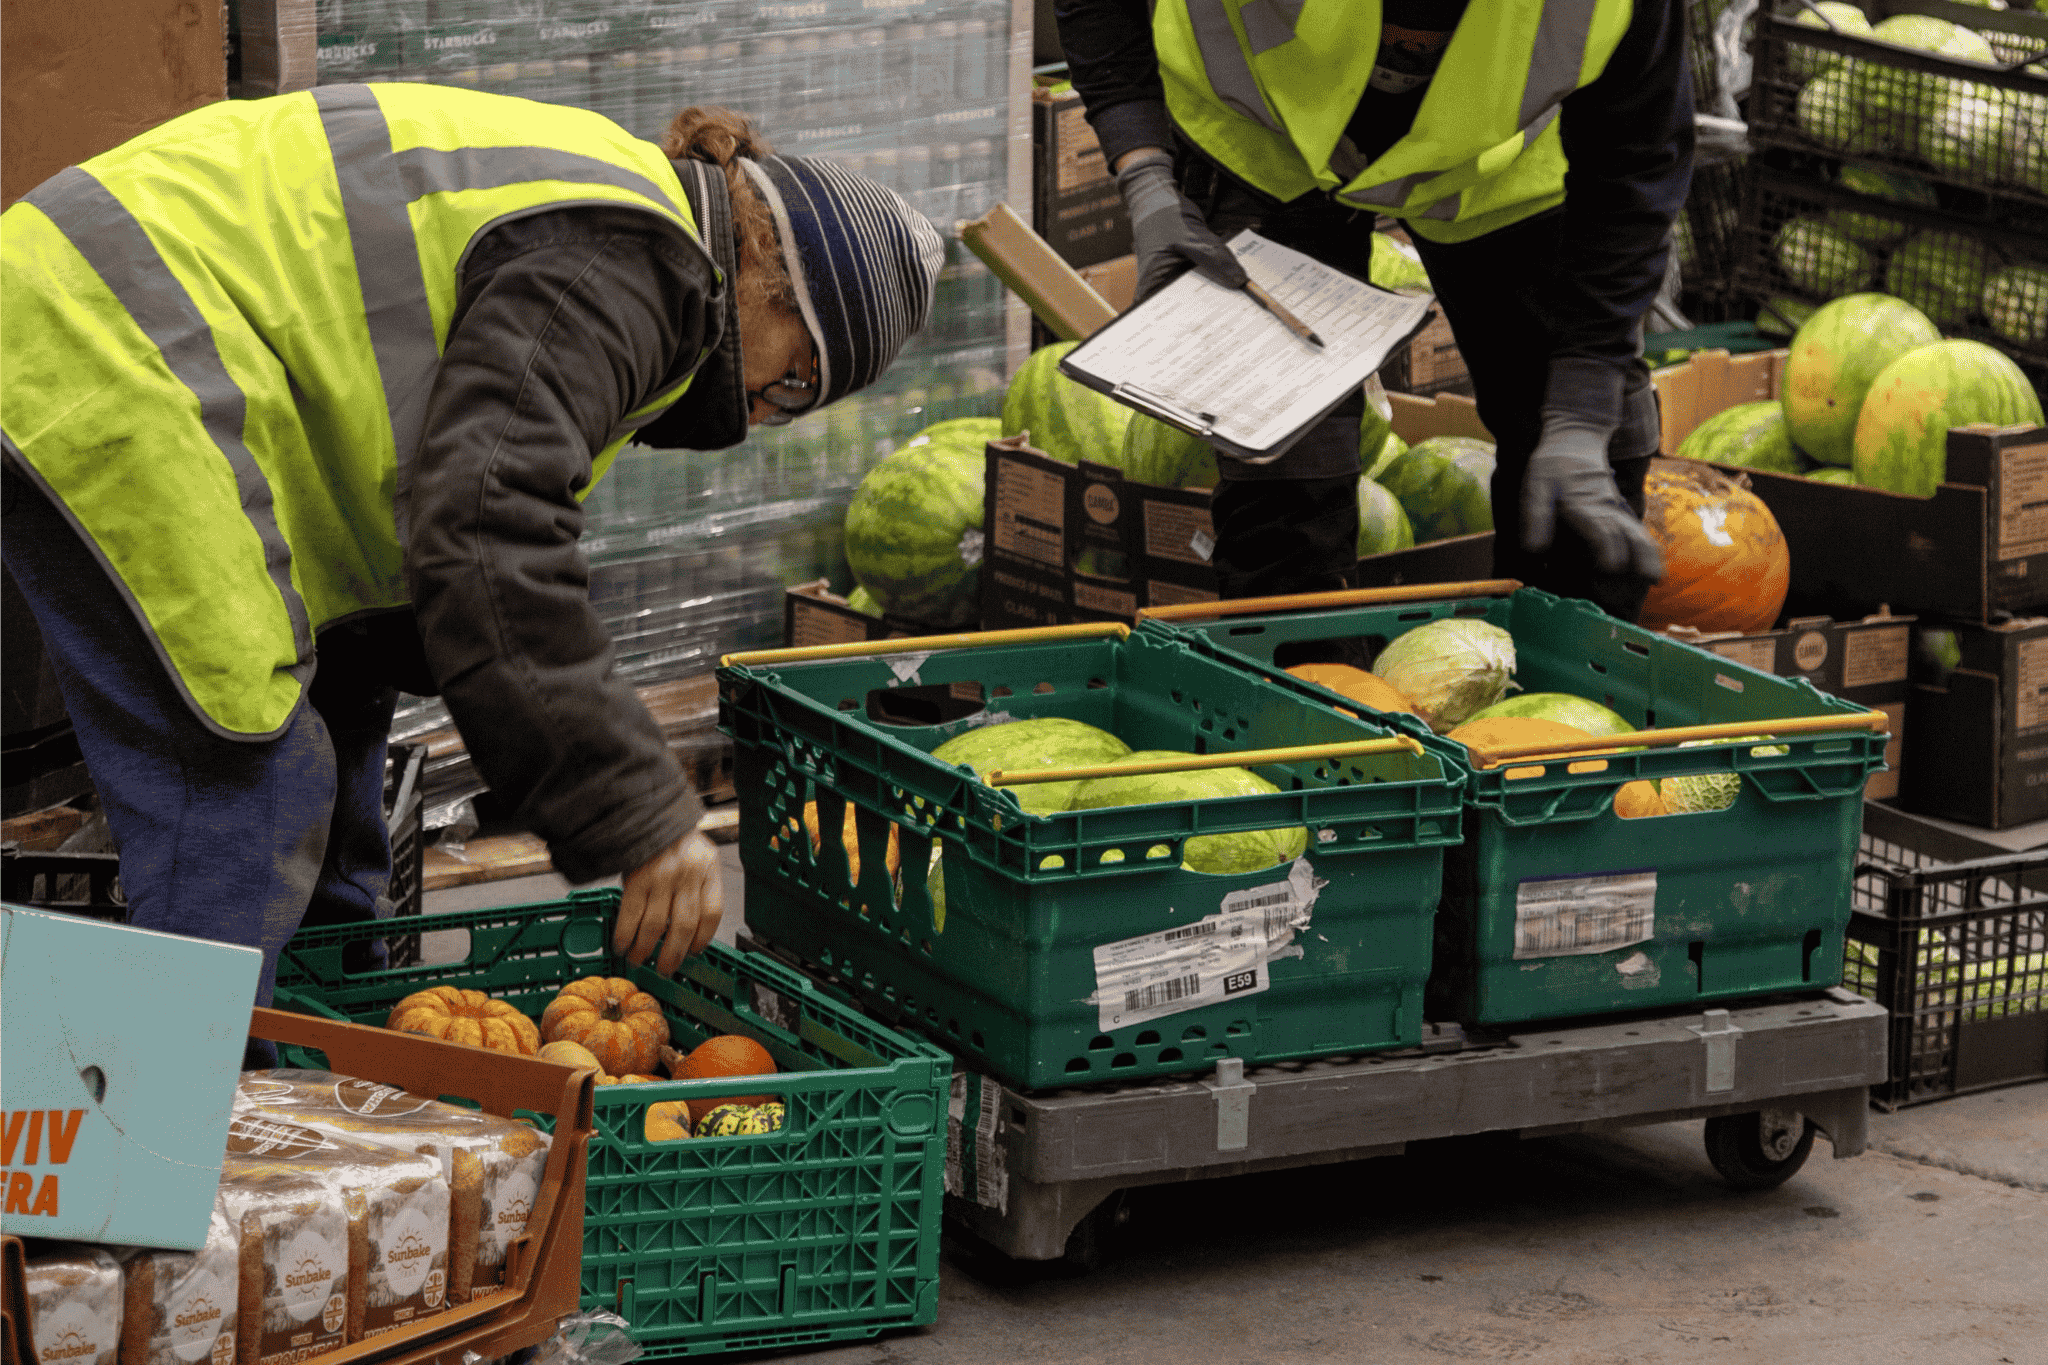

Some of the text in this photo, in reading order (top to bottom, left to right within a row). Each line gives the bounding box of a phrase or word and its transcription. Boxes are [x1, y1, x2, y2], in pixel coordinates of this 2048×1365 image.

[424, 32, 496, 50] STARBUCKS
[316, 43, 376, 60] ARBUCKS
[1228, 973, 1252, 990] E59
[0, 1109, 84, 1166] VIV
[498, 1208, 528, 1225] Sunba
[388, 1242, 430, 1264] Sunbake
[285, 1267, 331, 1290] Sunbake
[175, 1305, 221, 1328] Sunbake
[42, 1342, 96, 1362] Sunbake
